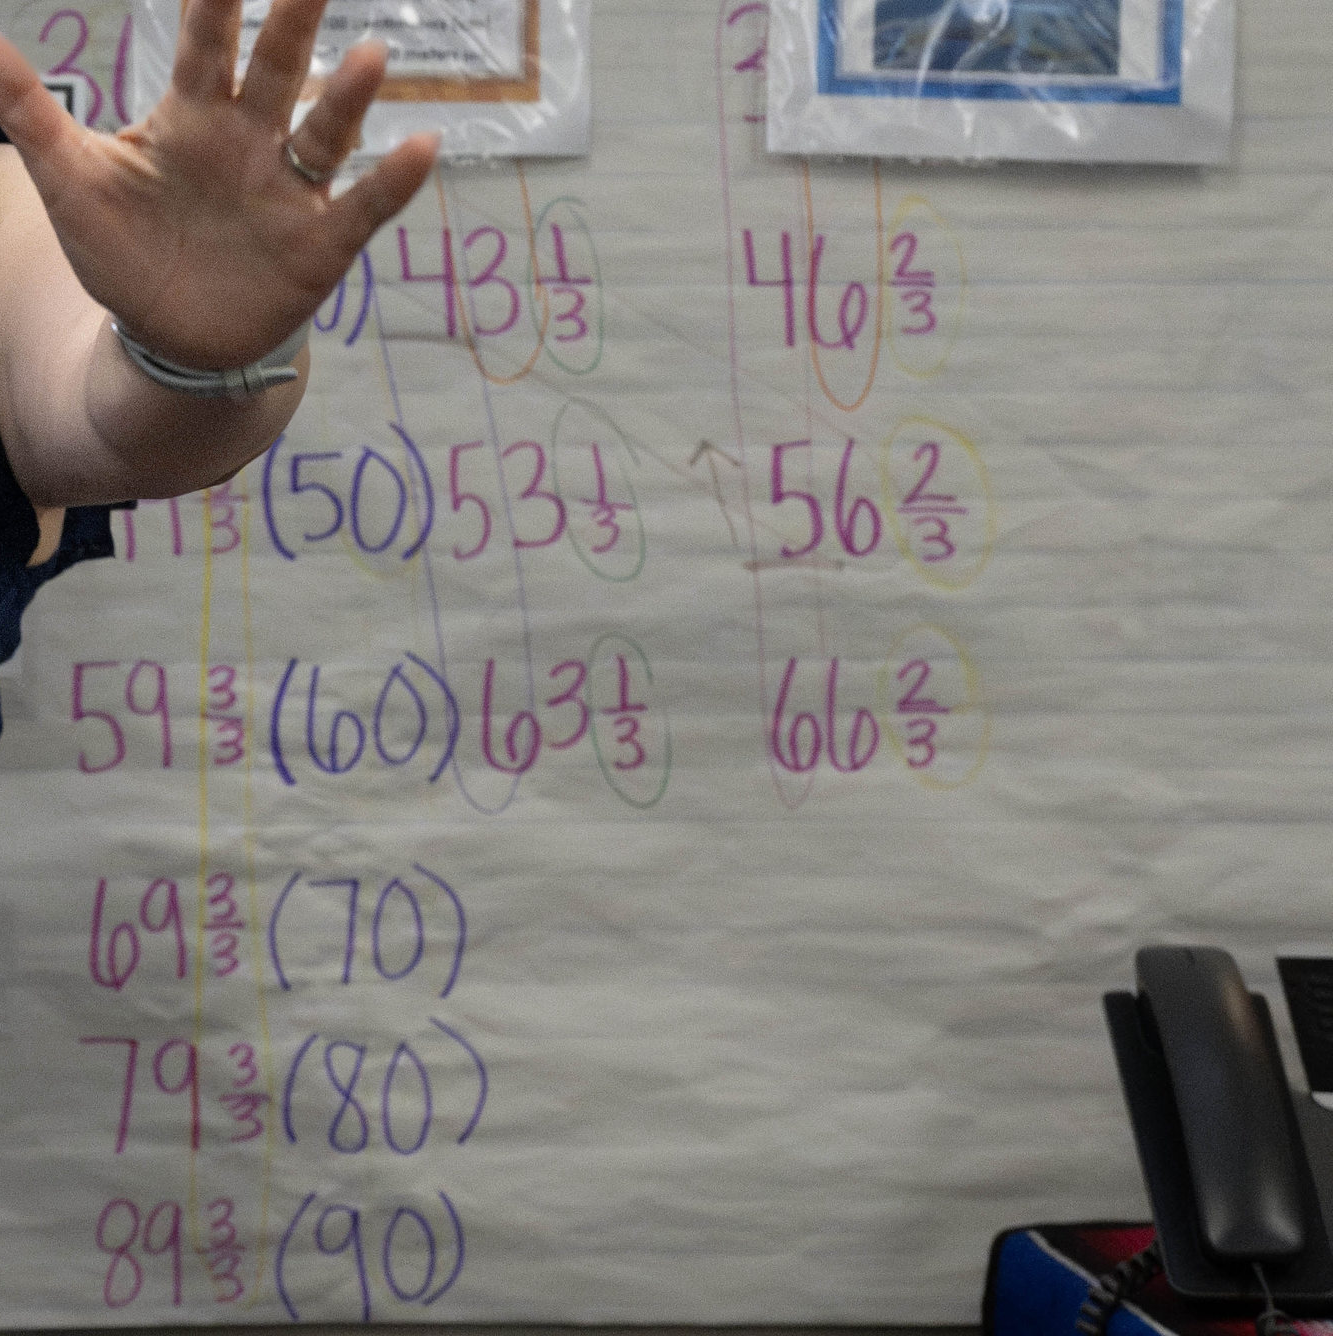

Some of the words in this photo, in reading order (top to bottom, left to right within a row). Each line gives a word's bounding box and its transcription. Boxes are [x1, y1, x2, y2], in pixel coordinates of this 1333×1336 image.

[743, 228, 868, 350] 46
[263, 420, 435, 562] (50)
[770, 436, 883, 558] 56
[71, 658, 175, 775] 59
[270, 649, 462, 786] (60)
[769, 655, 882, 774] 66
[88, 876, 188, 991] 69
[267, 862, 468, 999] (70)
[79, 1035, 202, 1155] 79
[281, 1016, 490, 1156] (80)
[95, 1196, 185, 1309] 89
[275, 1190, 466, 1323] (90)
